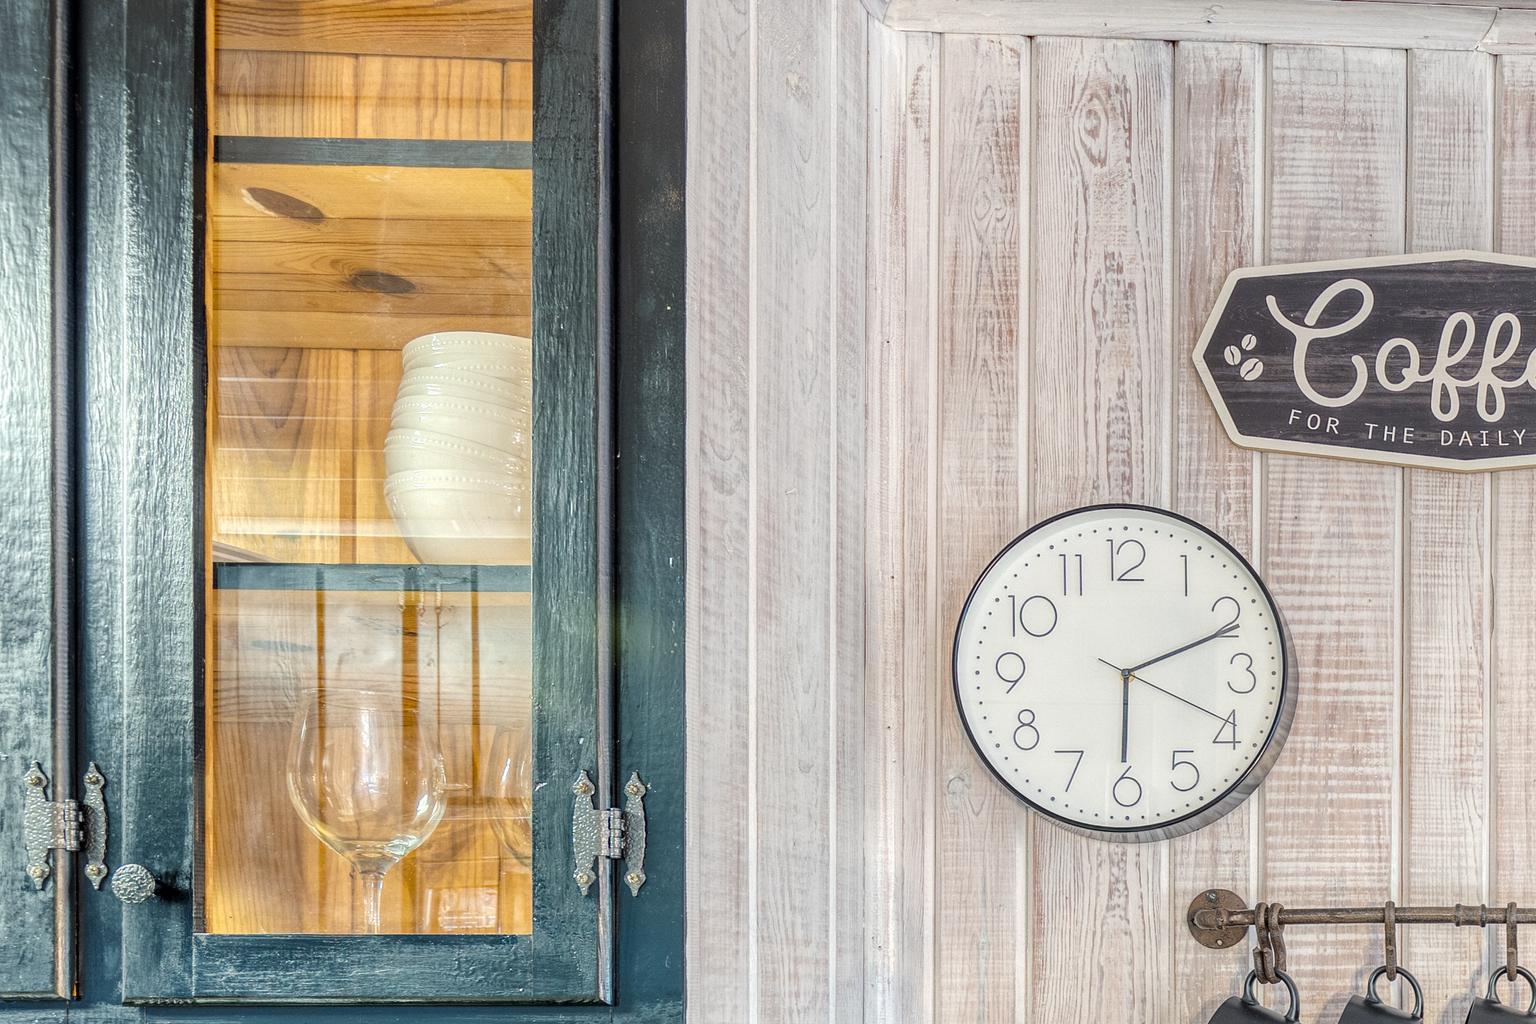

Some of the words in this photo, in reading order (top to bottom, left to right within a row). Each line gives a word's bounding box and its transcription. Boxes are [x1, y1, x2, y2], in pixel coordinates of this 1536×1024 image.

[1288, 408, 1340, 435] FOR
[1364, 422, 1415, 445] THE
[1440, 428, 1526, 447] DAILY
[1059, 554, 1082, 596] 11
[1106, 539, 1145, 581] 12
[1180, 555, 1188, 597] 1
[1008, 595, 1057, 637] 10
[1211, 596, 1241, 638] 2
[995, 652, 1026, 694] 9
[1227, 652, 1256, 693] 3
[1013, 708, 1040, 750] 8
[1212, 709, 1242, 750] 4
[1054, 750, 1084, 792] 7
[1112, 765, 1142, 807] 6
[1170, 750, 1200, 791] 5
